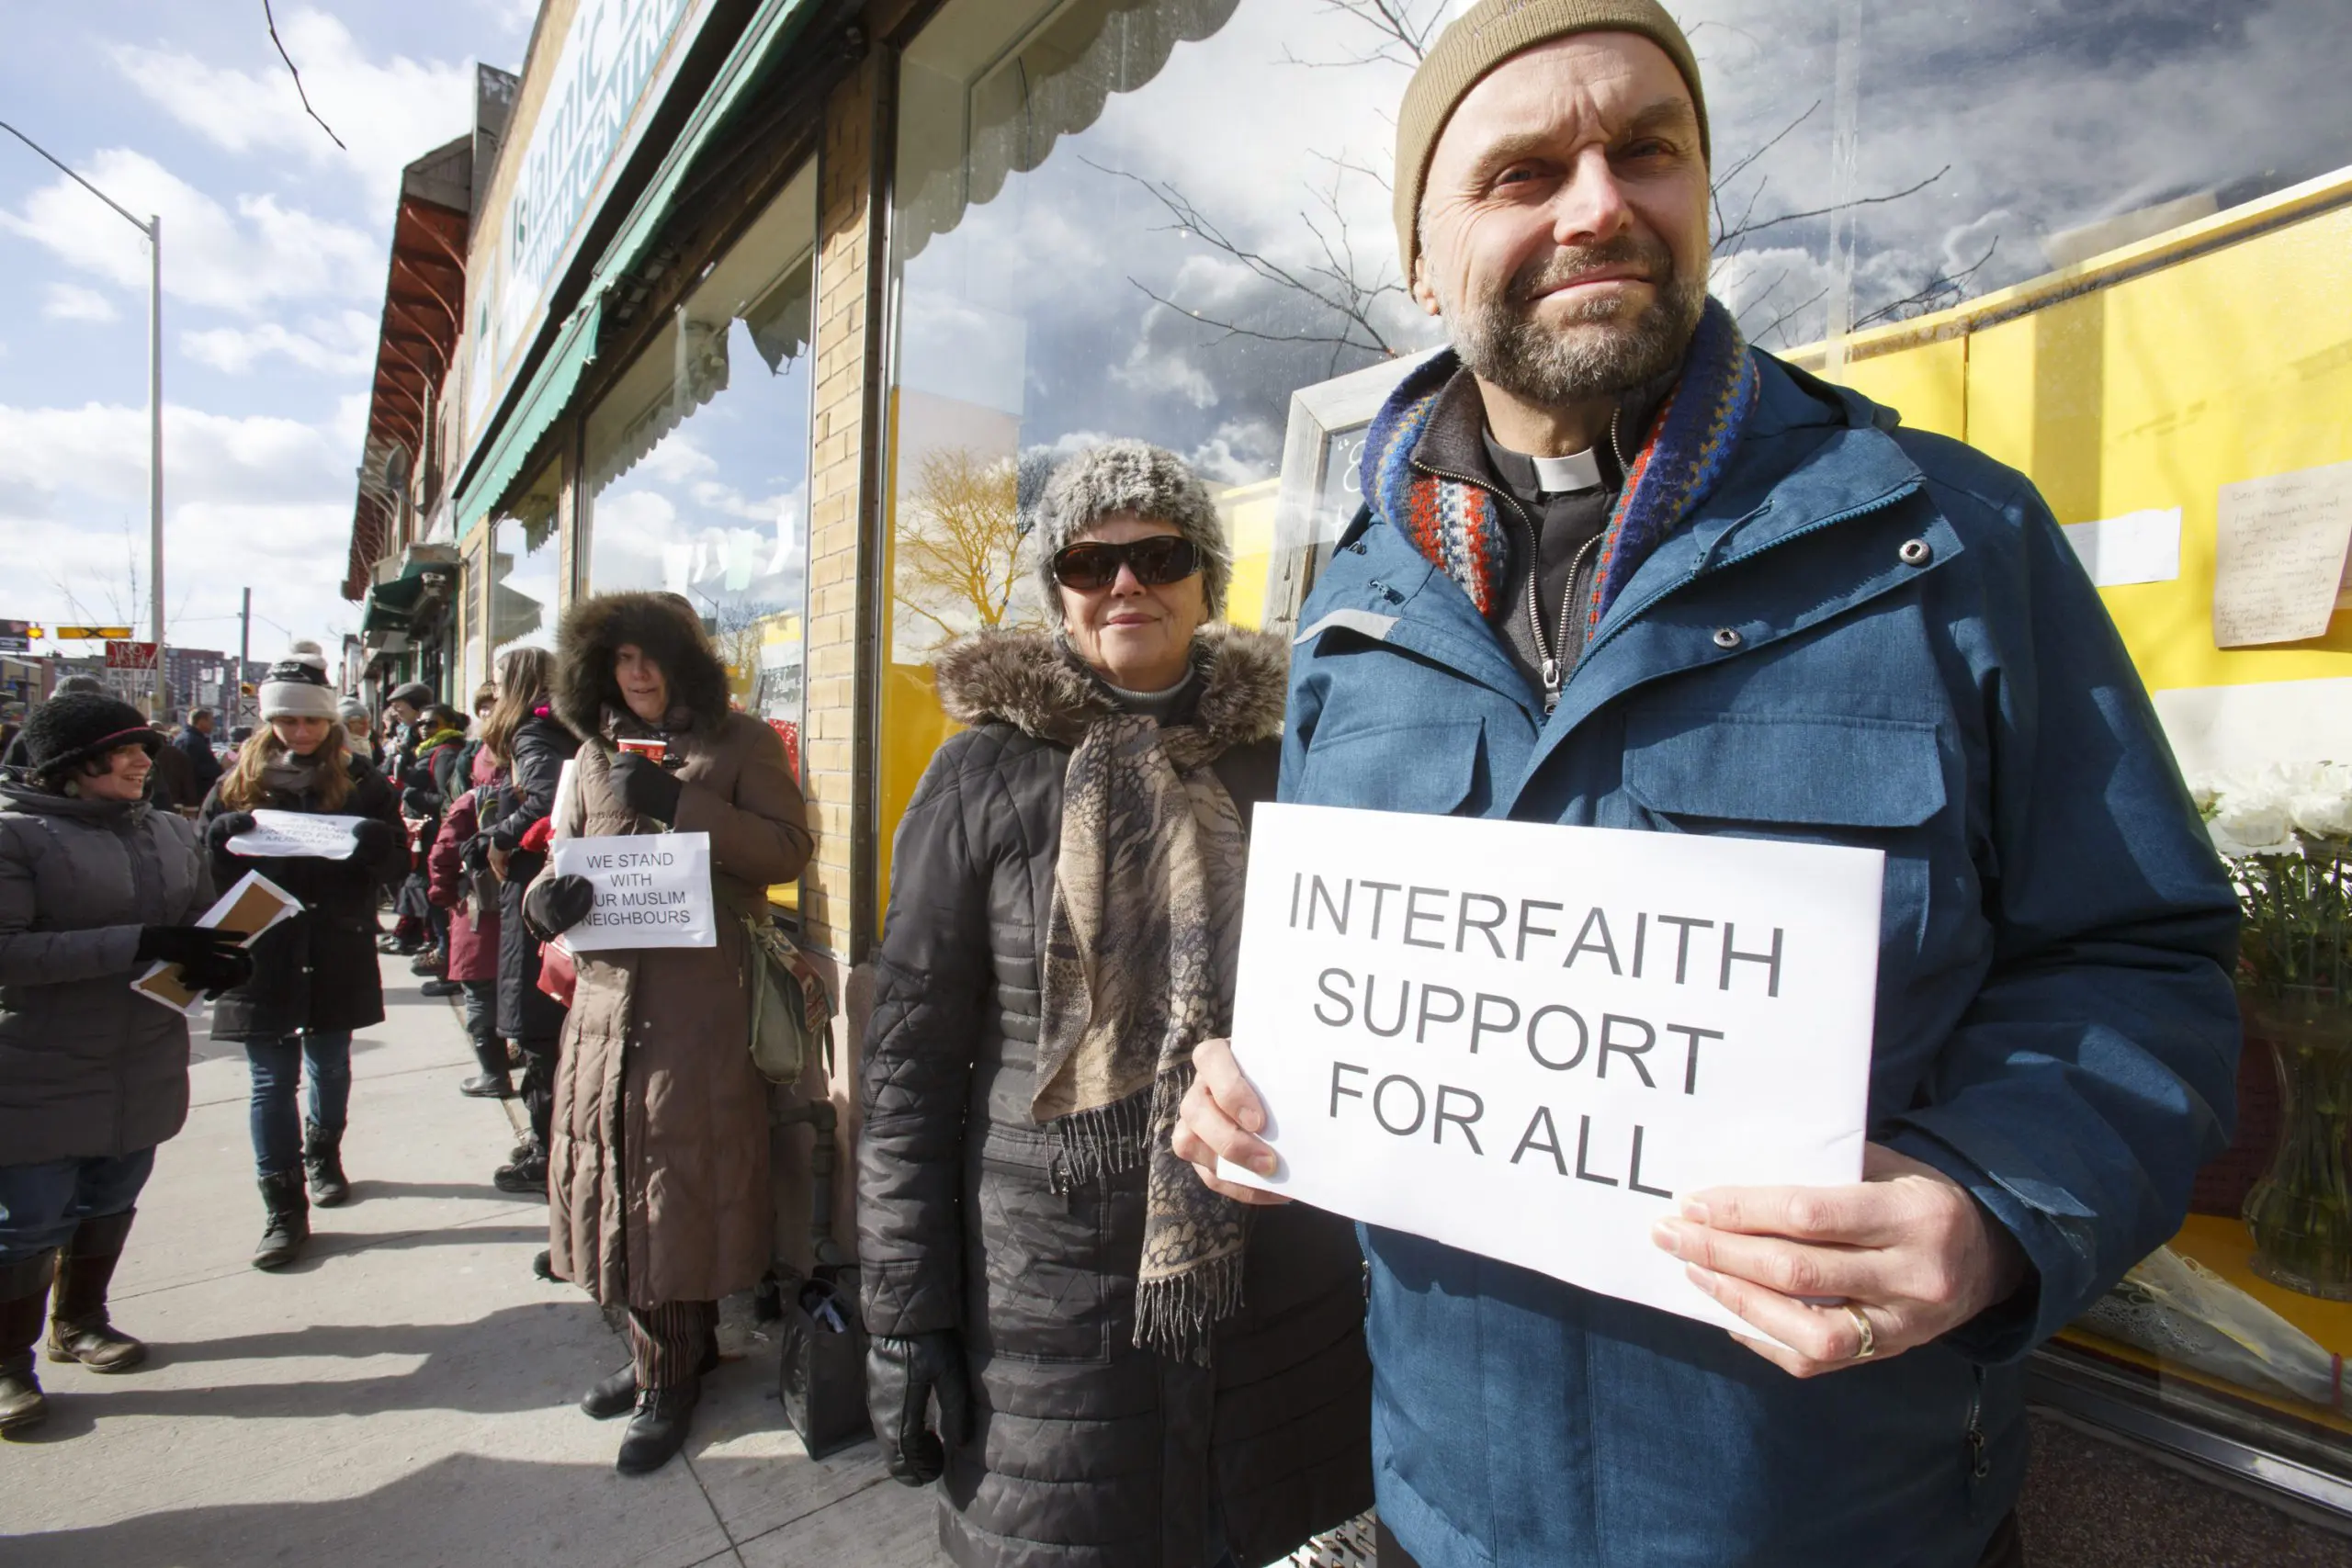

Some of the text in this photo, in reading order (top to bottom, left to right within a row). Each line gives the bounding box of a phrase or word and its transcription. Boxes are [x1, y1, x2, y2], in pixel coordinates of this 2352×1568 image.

[586, 852, 674, 869] WE STAND
[610, 873, 651, 887] WITH
[594, 890, 685, 908] UR MUSLIM
[582, 909, 690, 926] NEIGHBOURS
[1289, 872, 1784, 998] INTERFAITH
[1314, 967, 1724, 1095] SUPPORT
[1329, 1061, 1673, 1200] FOR ALL
